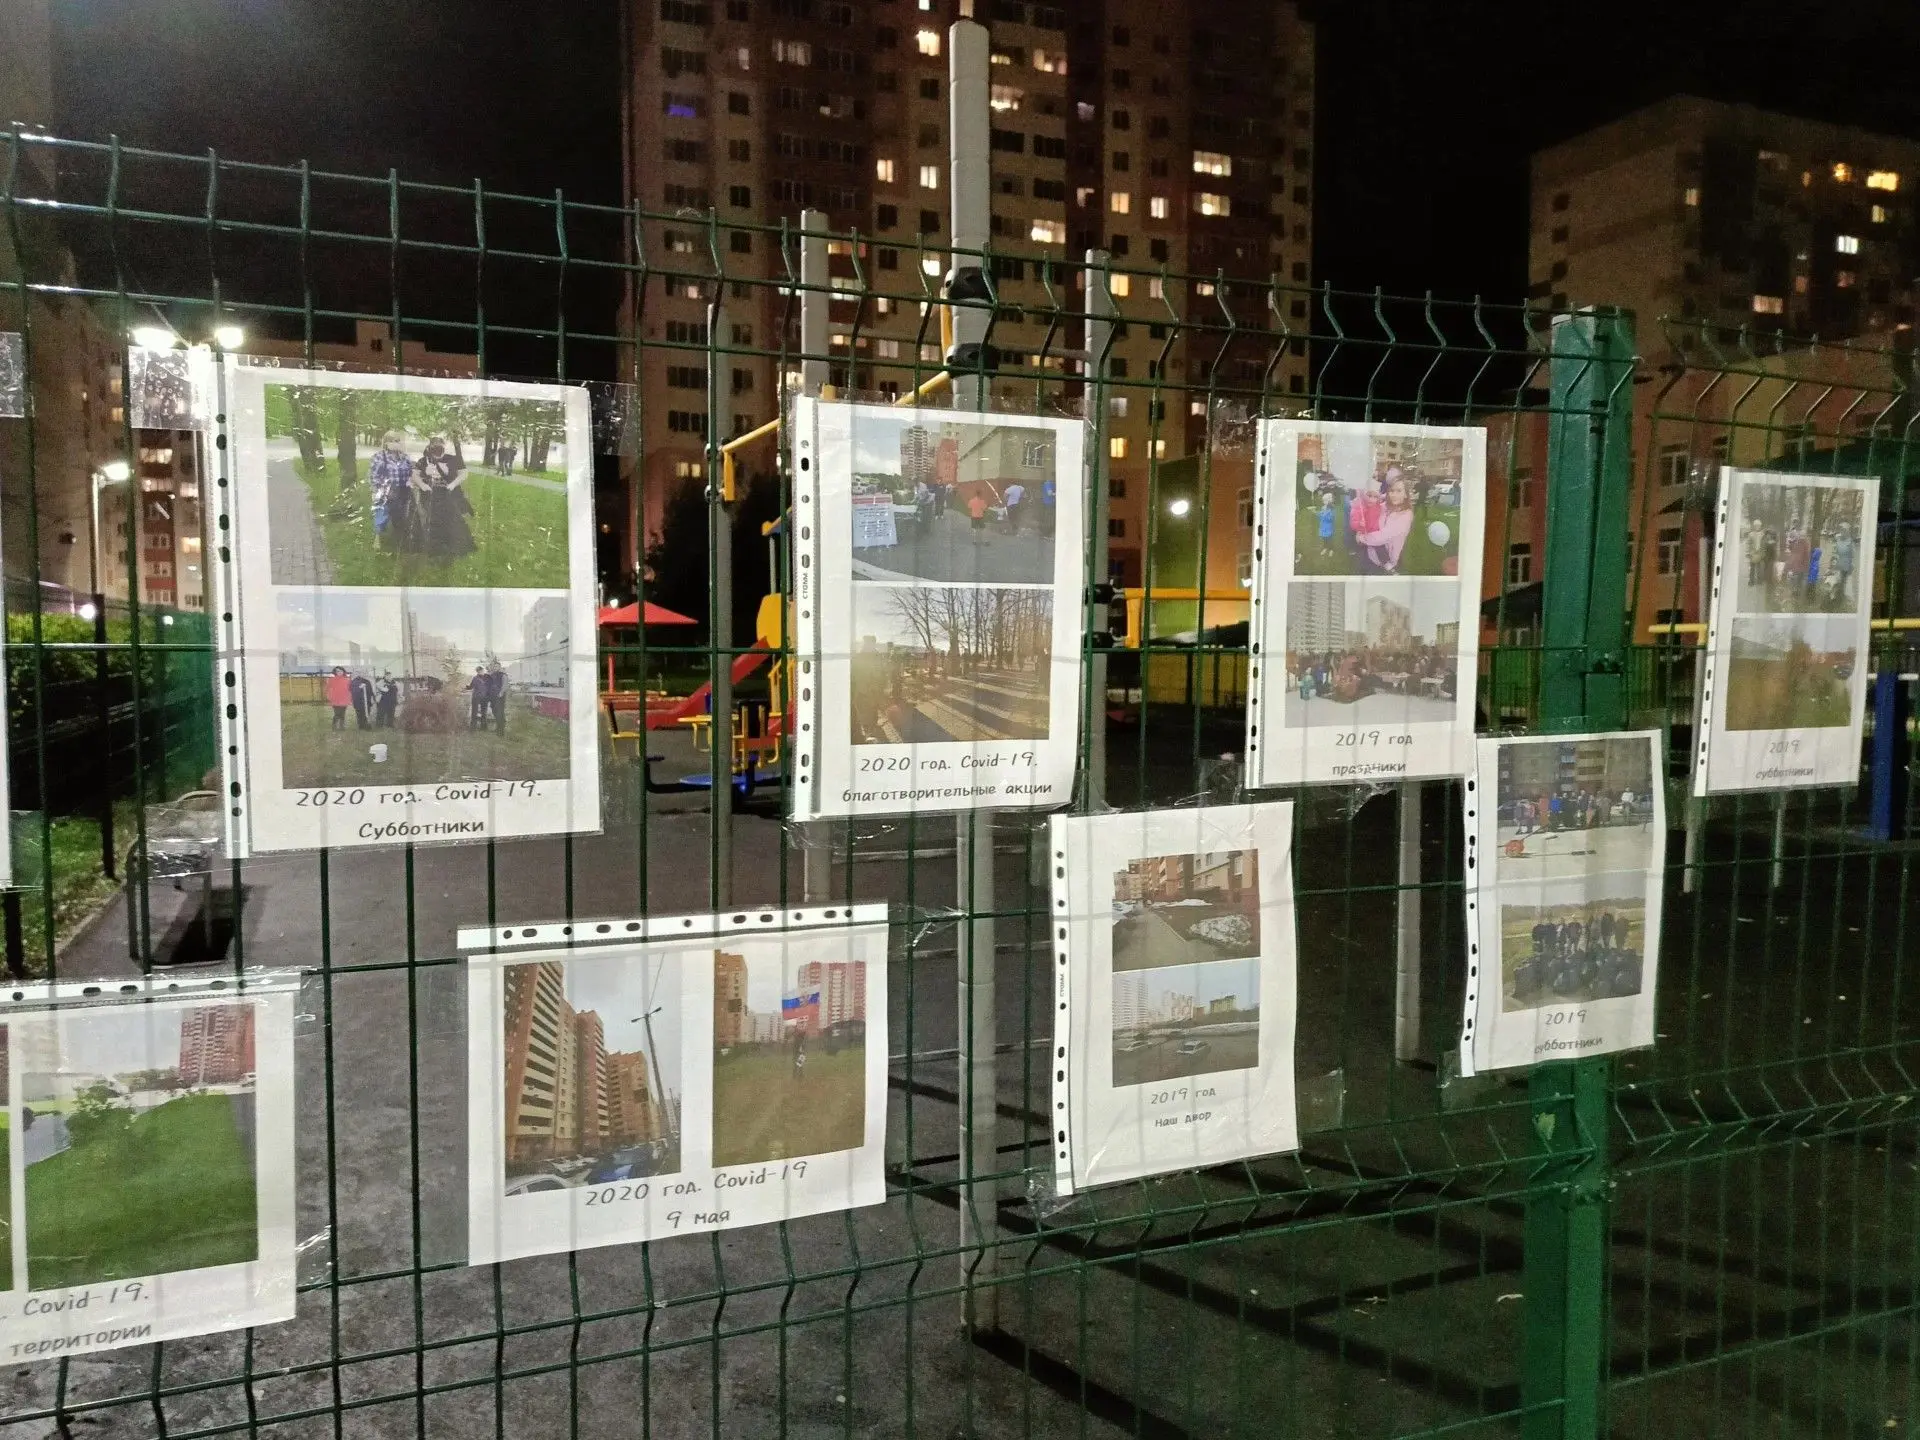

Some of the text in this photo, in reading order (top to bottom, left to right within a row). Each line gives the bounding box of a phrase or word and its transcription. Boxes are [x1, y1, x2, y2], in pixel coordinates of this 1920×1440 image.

[1336, 731, 1413, 746] 2019 год
[1769, 740, 1800, 753] 2019
[861, 752, 1038, 771] 2020 год. Covid-19.
[297, 780, 542, 807] 2020 год. Covid-19.
[842, 783, 1052, 802] благотворительные акции
[358, 821, 485, 840] Субботники
[1545, 1009, 1587, 1025] 2019
[1151, 1088, 1216, 1104] 2019 год
[585, 1160, 808, 1206] 2020 год. Covid-19
[667, 1210, 730, 1228] 9 мая
[23, 1282, 149, 1316] Covid-19.
[10, 1324, 152, 1357] территории
